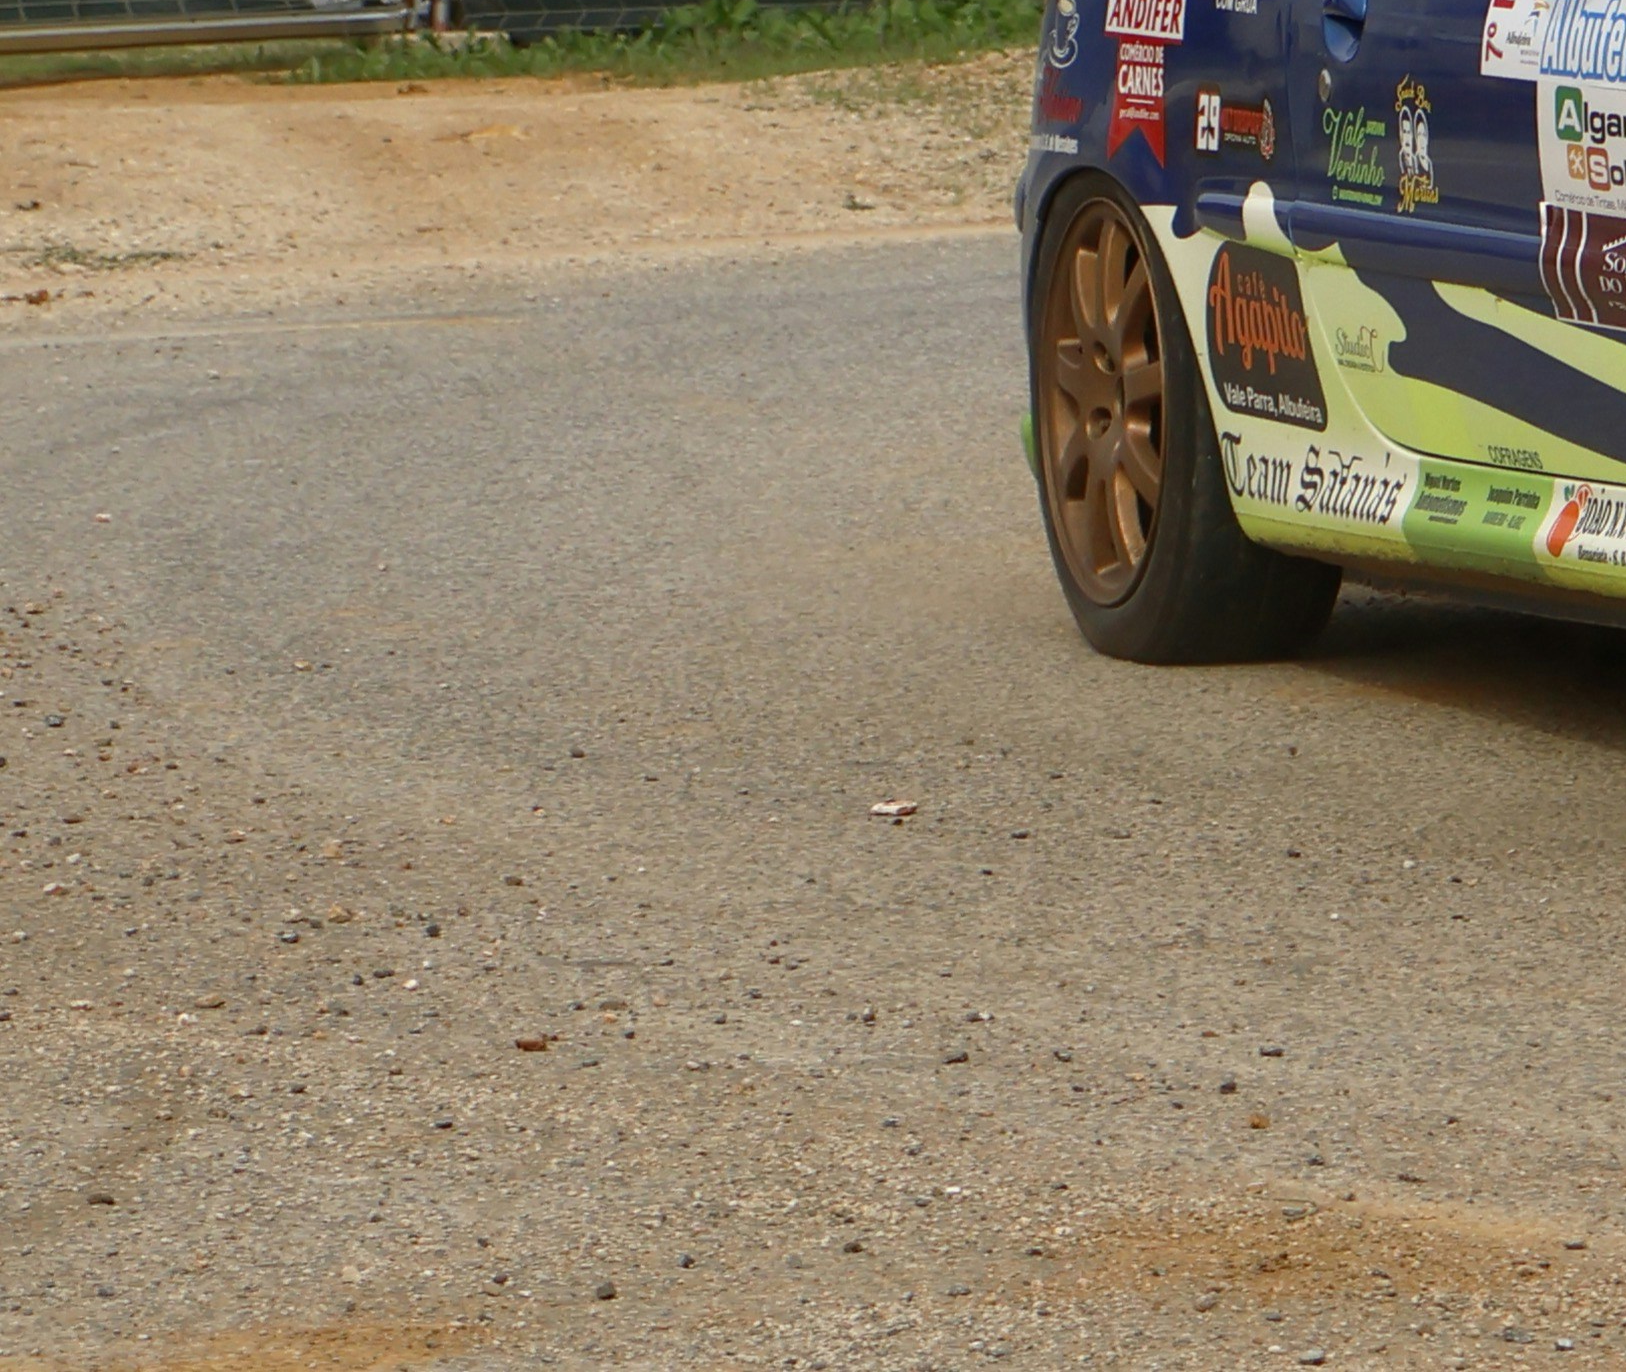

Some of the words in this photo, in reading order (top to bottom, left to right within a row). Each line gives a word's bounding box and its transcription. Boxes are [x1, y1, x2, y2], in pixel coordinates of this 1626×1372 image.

[1118, 64, 1164, 97] CARNES
[1599, 276, 1622, 294] DO
[1223, 381, 1247, 408] Vale
[1278, 392, 1323, 424] Albufeira
[1221, 431, 1292, 506] Team
[1487, 445, 1543, 470] COFRAGENS
